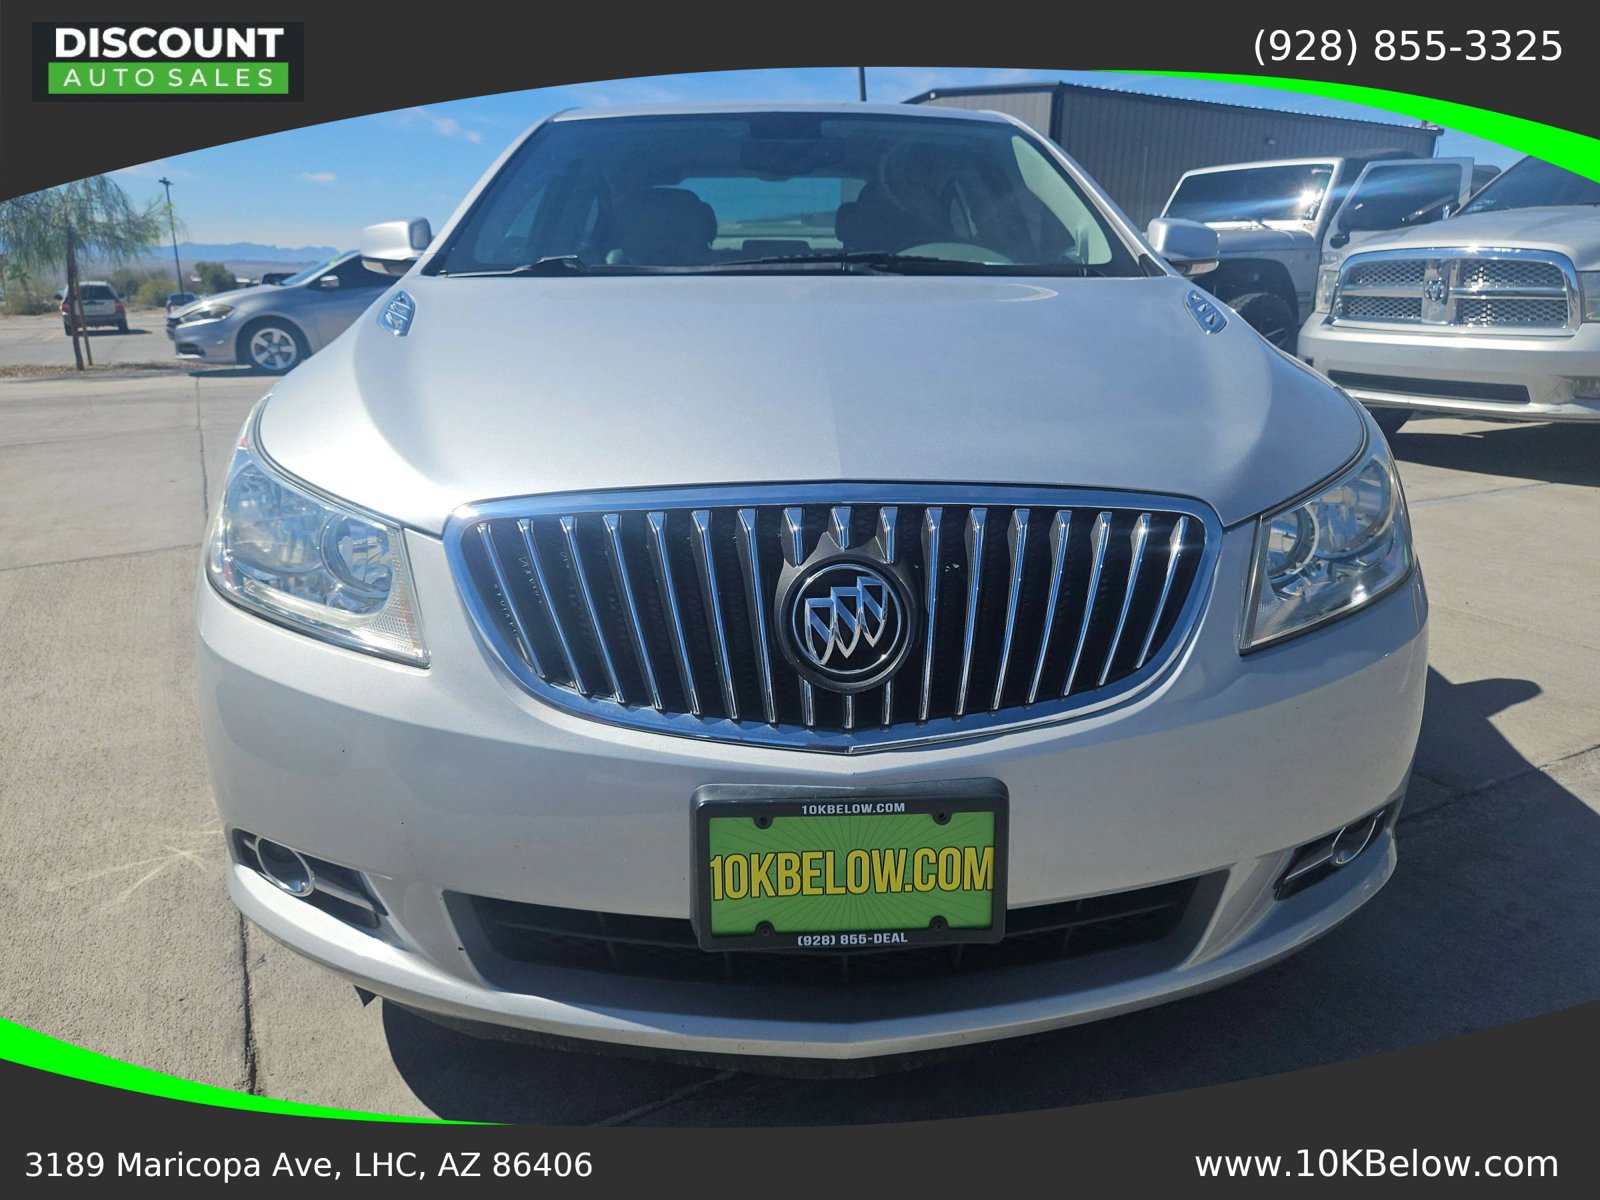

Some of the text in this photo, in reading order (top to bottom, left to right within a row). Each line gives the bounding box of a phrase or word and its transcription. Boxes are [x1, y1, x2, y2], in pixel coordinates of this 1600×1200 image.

[802, 802, 906, 815] 10KBELOW.COM
[709, 846, 995, 901] 10KBELOW.COM
[796, 932, 909, 947] (928) 855-DEAL
